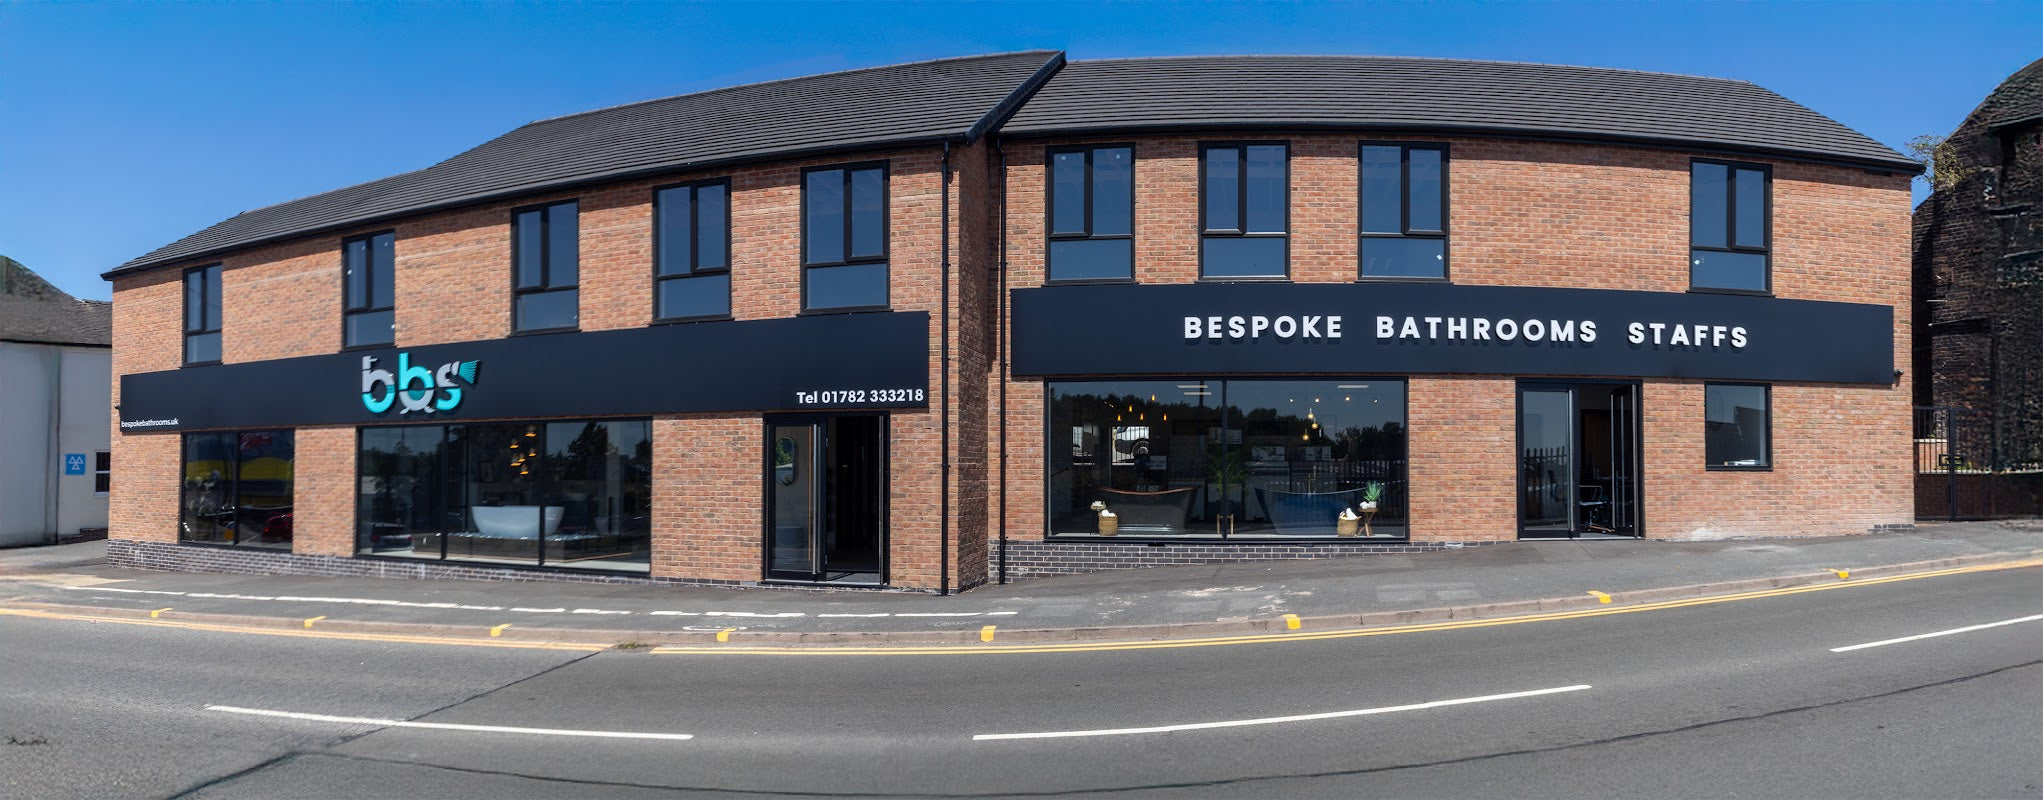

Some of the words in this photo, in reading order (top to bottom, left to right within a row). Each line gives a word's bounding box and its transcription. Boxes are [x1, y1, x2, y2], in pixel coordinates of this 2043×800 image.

[1184, 315, 1342, 339] BESPOKE
[1376, 315, 1597, 343] BATHROOMS
[1628, 321, 1748, 348] STAFFS
[362, 352, 480, 415] bbs
[797, 391, 818, 404] Tel
[822, 390, 866, 403] 01782
[870, 389, 924, 402] 333218
[121, 417, 179, 429] bespokebathrooms.uk
